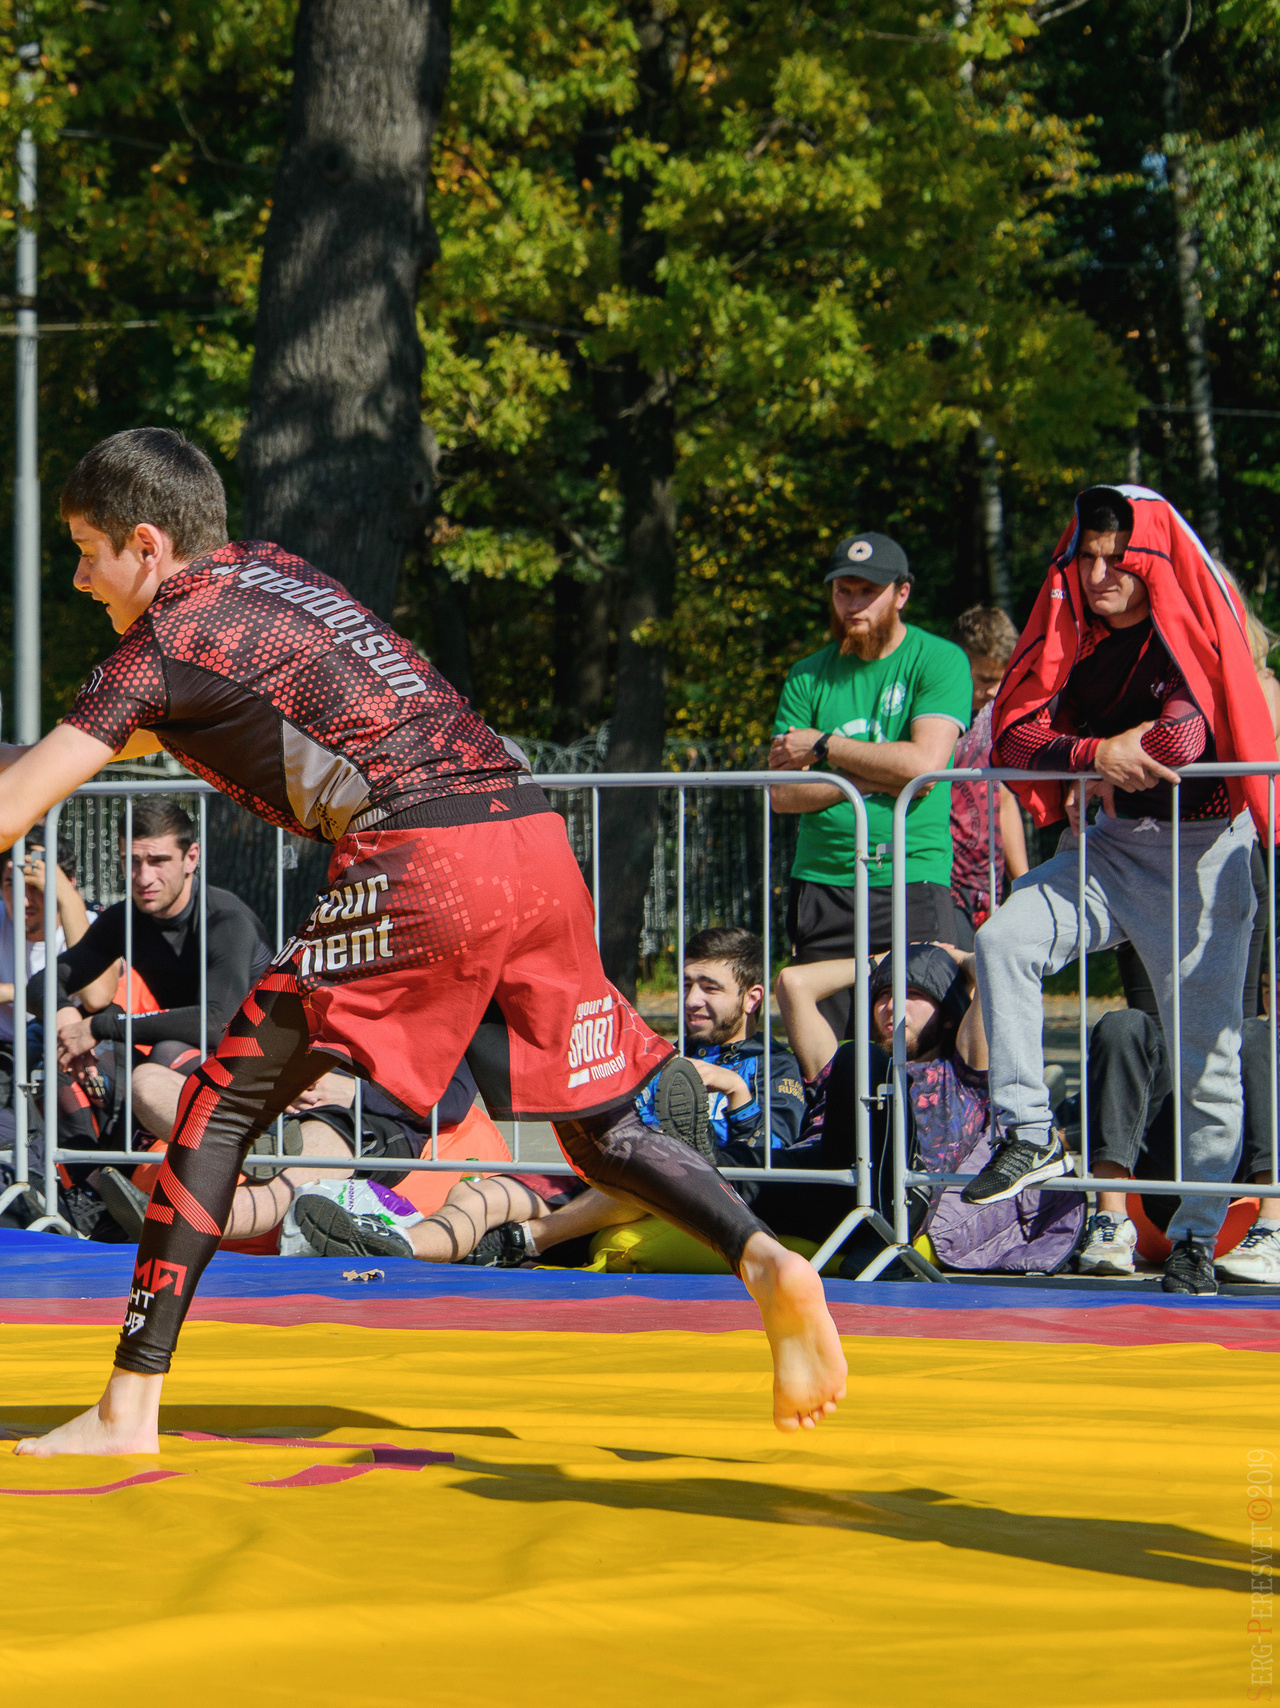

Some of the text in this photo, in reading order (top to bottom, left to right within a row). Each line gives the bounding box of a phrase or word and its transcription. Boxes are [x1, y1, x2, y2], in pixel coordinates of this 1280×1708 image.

[210, 560, 427, 698] unstoppab
[574, 999, 602, 1021] your
[568, 1014, 614, 1069] SPORT
[590, 1050, 626, 1081] moment
[129, 1287, 155, 1310] HT
[123, 1311, 146, 1336] UB
